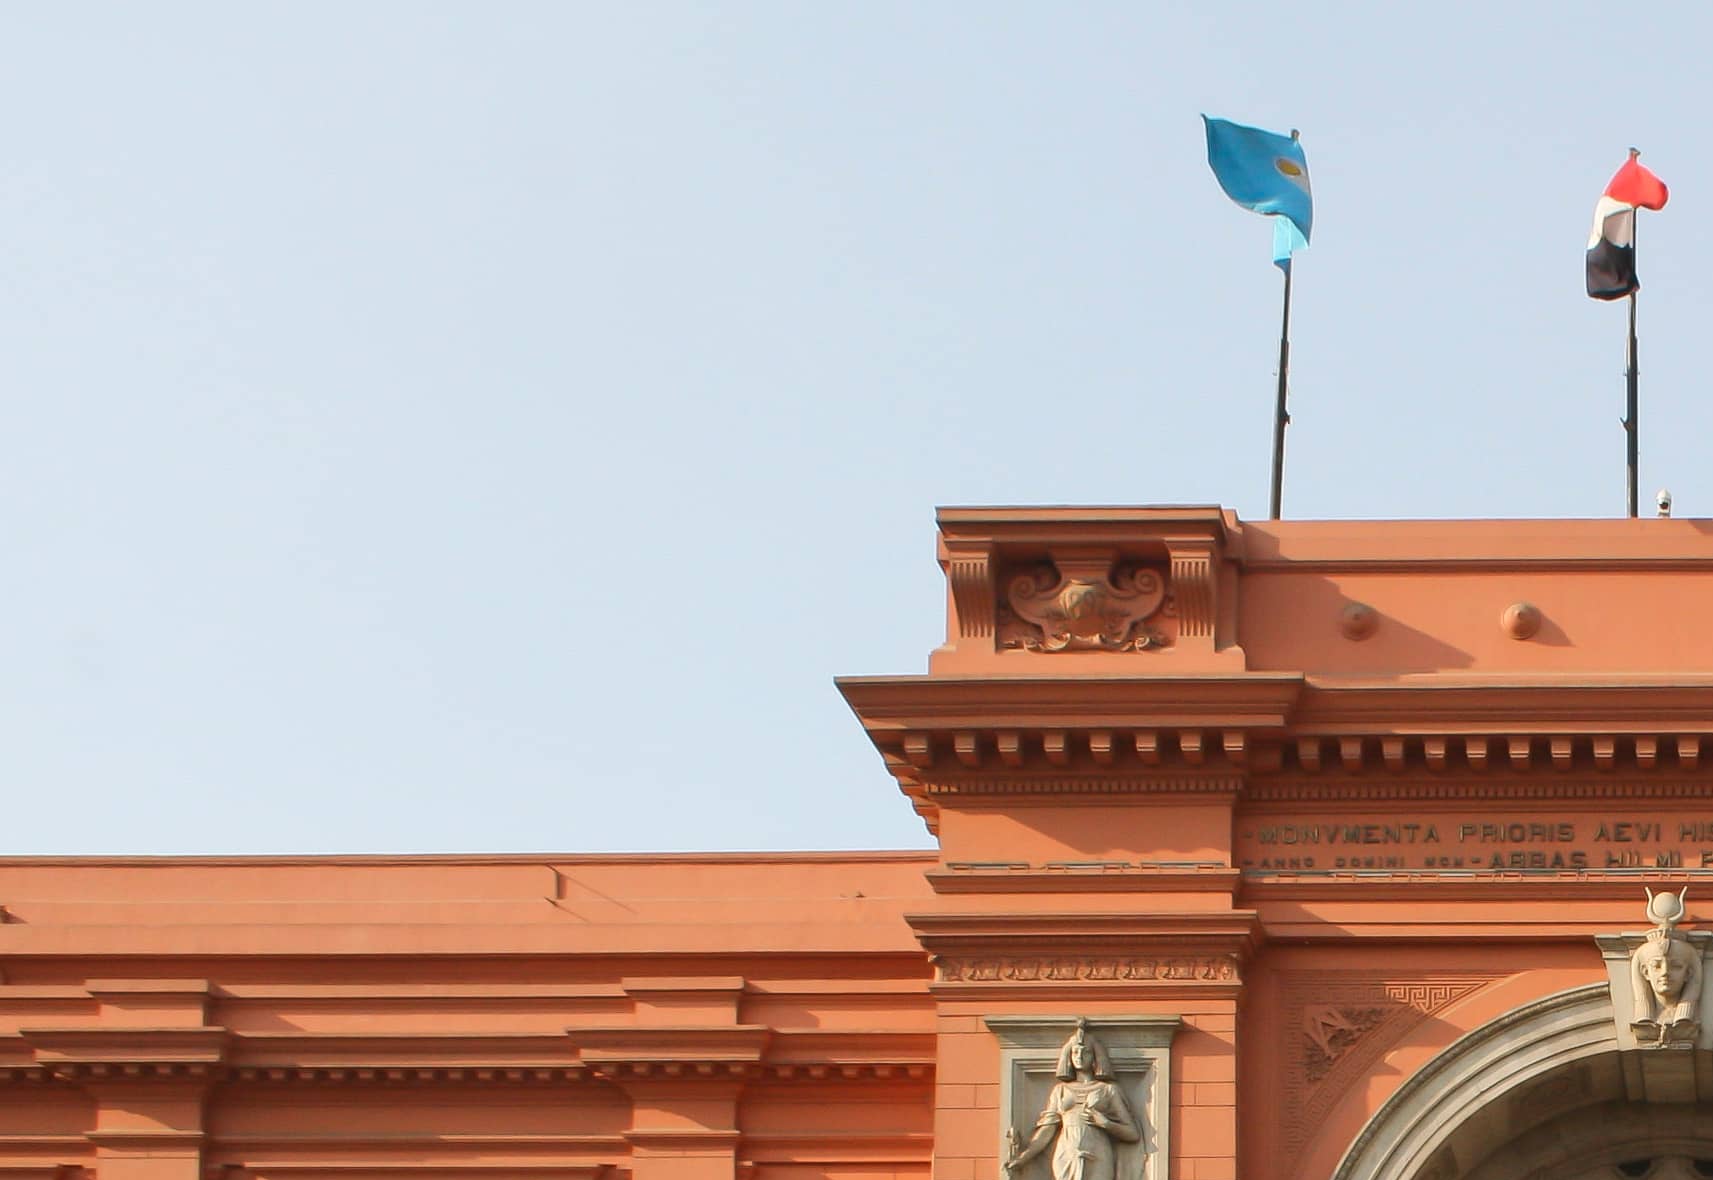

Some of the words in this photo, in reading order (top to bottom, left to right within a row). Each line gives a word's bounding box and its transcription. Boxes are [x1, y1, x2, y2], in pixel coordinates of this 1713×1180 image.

[1258, 823, 1440, 845] MONVMENTA
[1458, 822, 1575, 843] PRIORIS
[1594, 822, 1661, 843] AEVI
